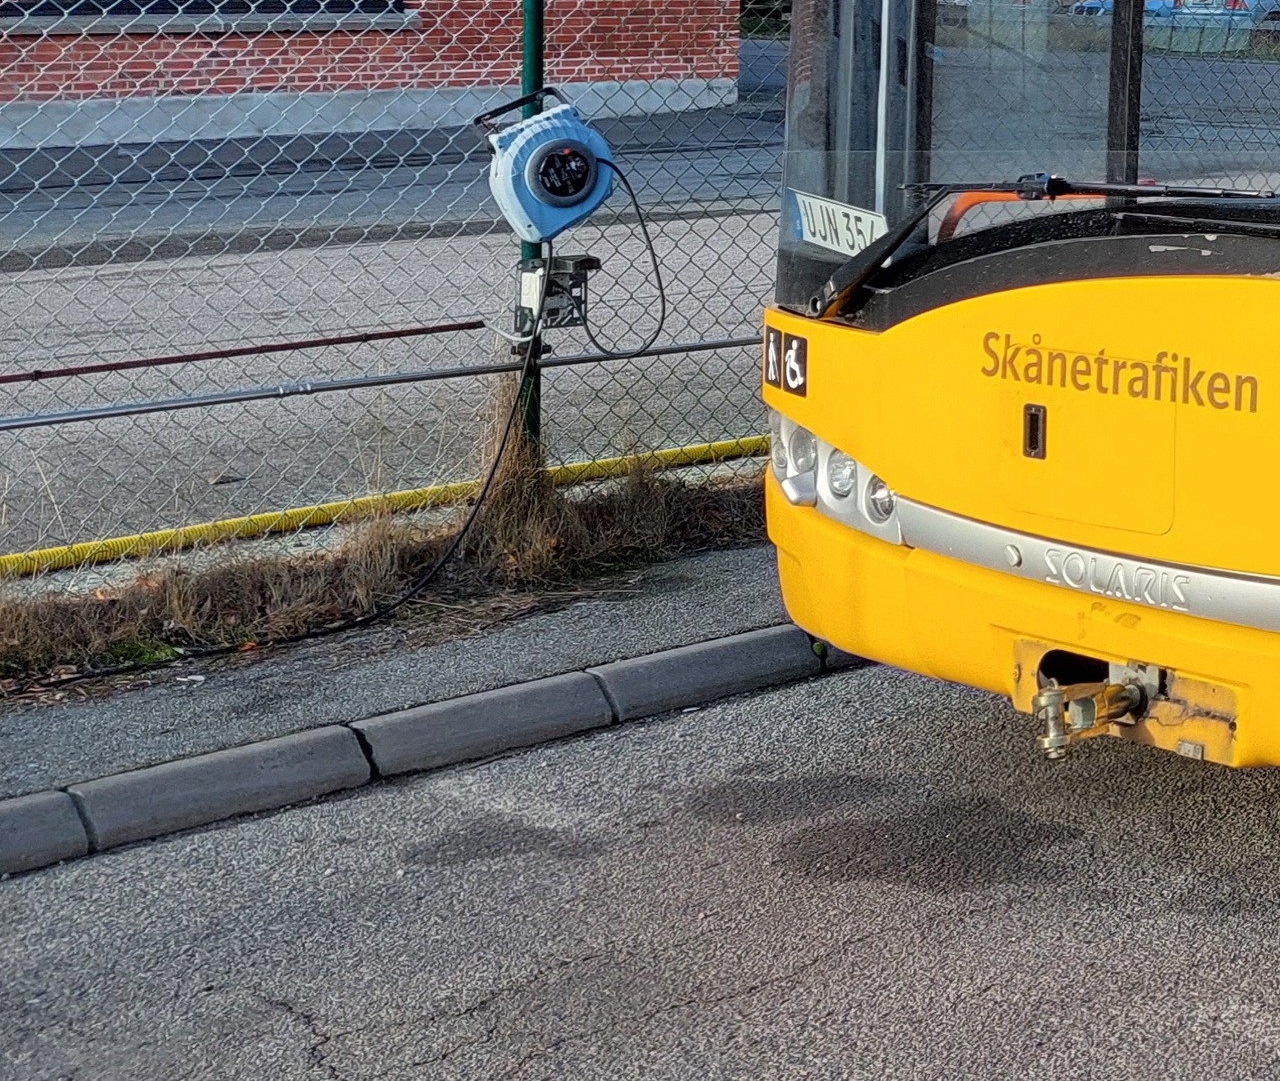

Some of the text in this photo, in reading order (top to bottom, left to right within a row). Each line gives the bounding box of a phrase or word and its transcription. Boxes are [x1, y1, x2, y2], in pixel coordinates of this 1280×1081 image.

[802, 199, 840, 247] UJN
[981, 331, 1258, 414] Skånetrafiken
[1044, 548, 1190, 612] SOLARIS
